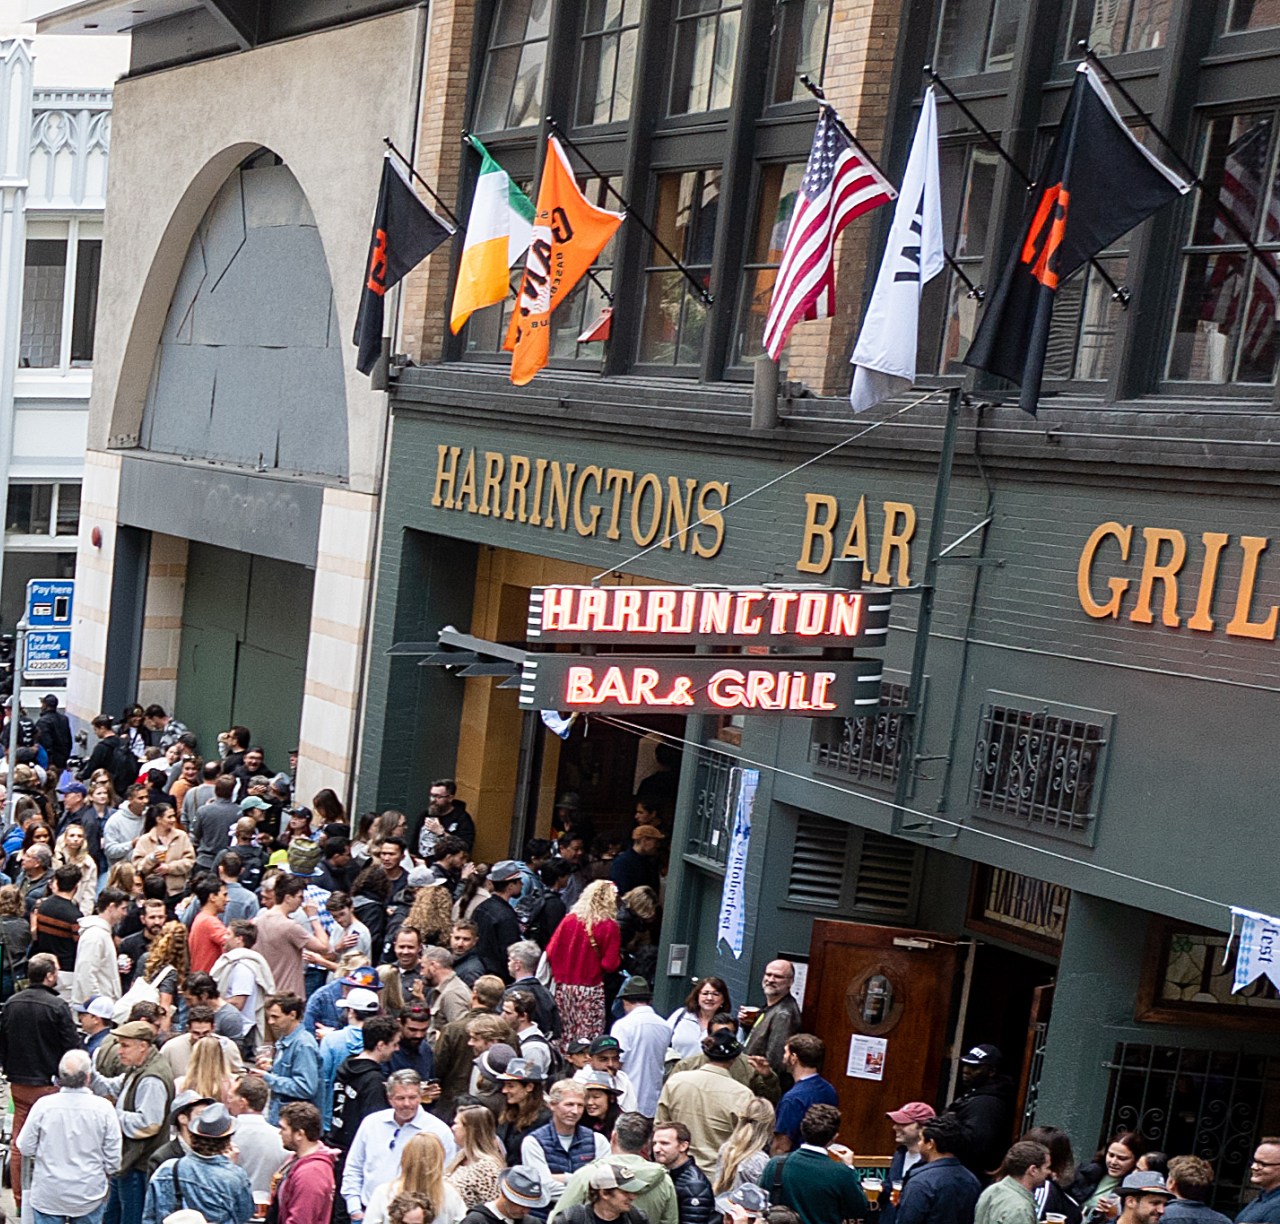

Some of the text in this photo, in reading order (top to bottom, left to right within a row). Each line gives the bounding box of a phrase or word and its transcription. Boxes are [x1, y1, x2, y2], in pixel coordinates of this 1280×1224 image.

[431, 444, 917, 586] HARRINGTONS BAR
[32, 584, 72, 596] Pay here
[542, 589, 862, 636] HARRINGTON
[29, 633, 59, 644] Pay by
[28, 642, 61, 650] License
[28, 651, 51, 660] Plate
[567, 667, 837, 710] BAR & GRILL
